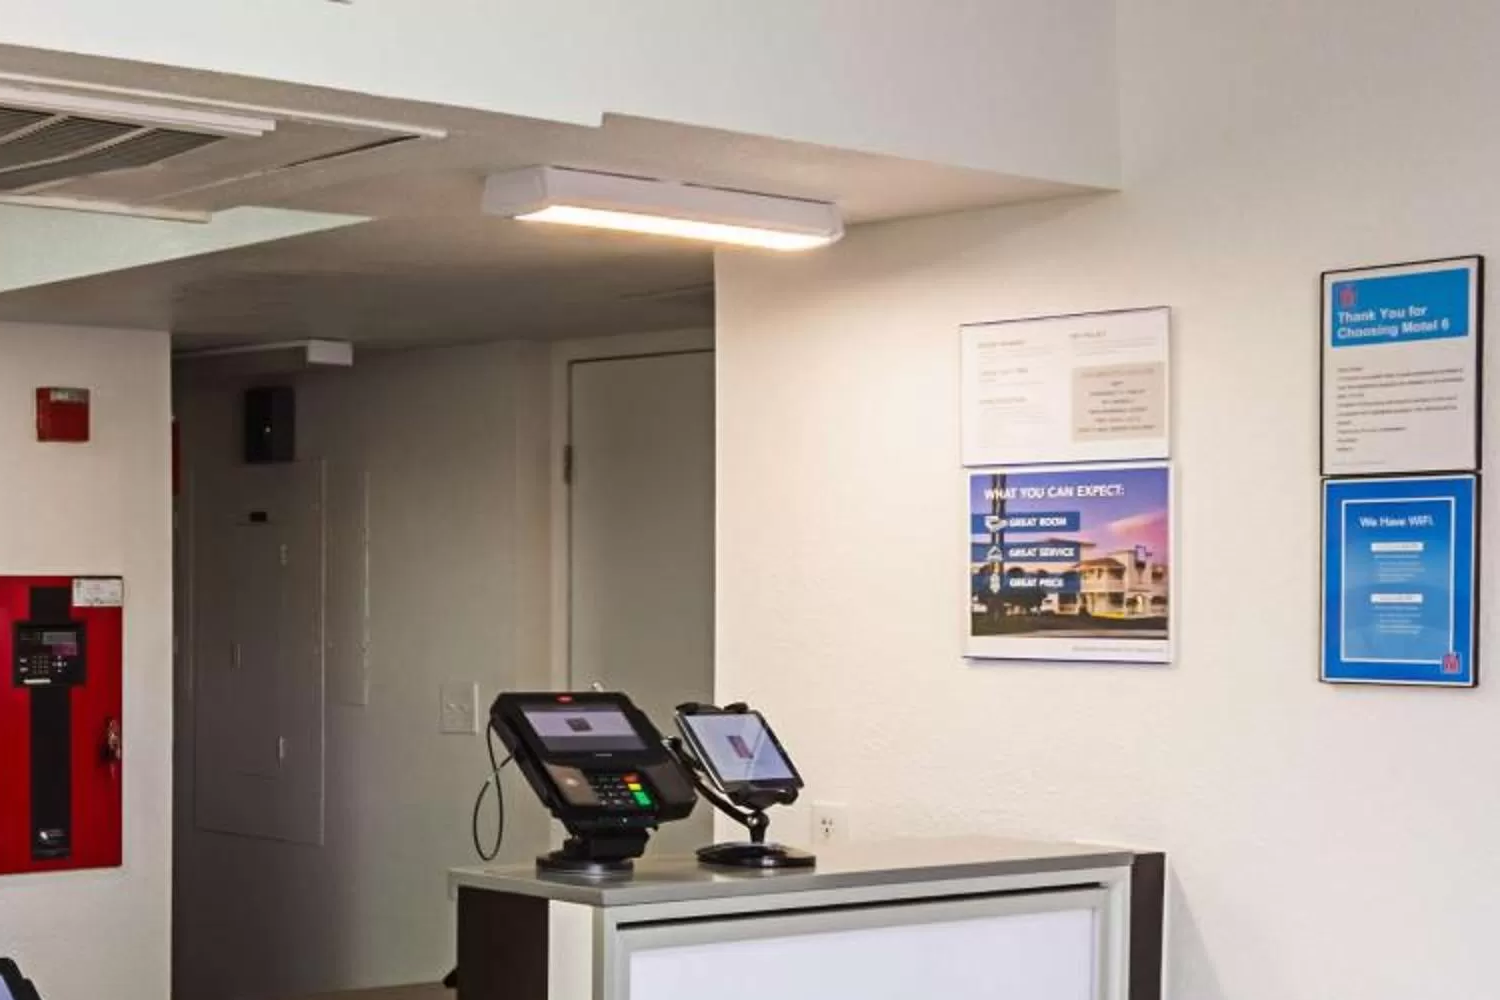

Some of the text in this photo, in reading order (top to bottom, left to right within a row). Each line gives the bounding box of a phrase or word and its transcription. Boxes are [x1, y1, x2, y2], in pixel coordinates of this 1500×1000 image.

[1337, 305, 1428, 325] Thank You for
[1337, 325, 1399, 339] Choosing
[1401, 319, 1438, 333] Motel
[984, 483, 1125, 499] WHAT YOU CAN EXPECT:
[1008, 518, 1037, 527] GREAT
[1359, 516, 1378, 528] We
[1008, 548, 1037, 557] GREAT
